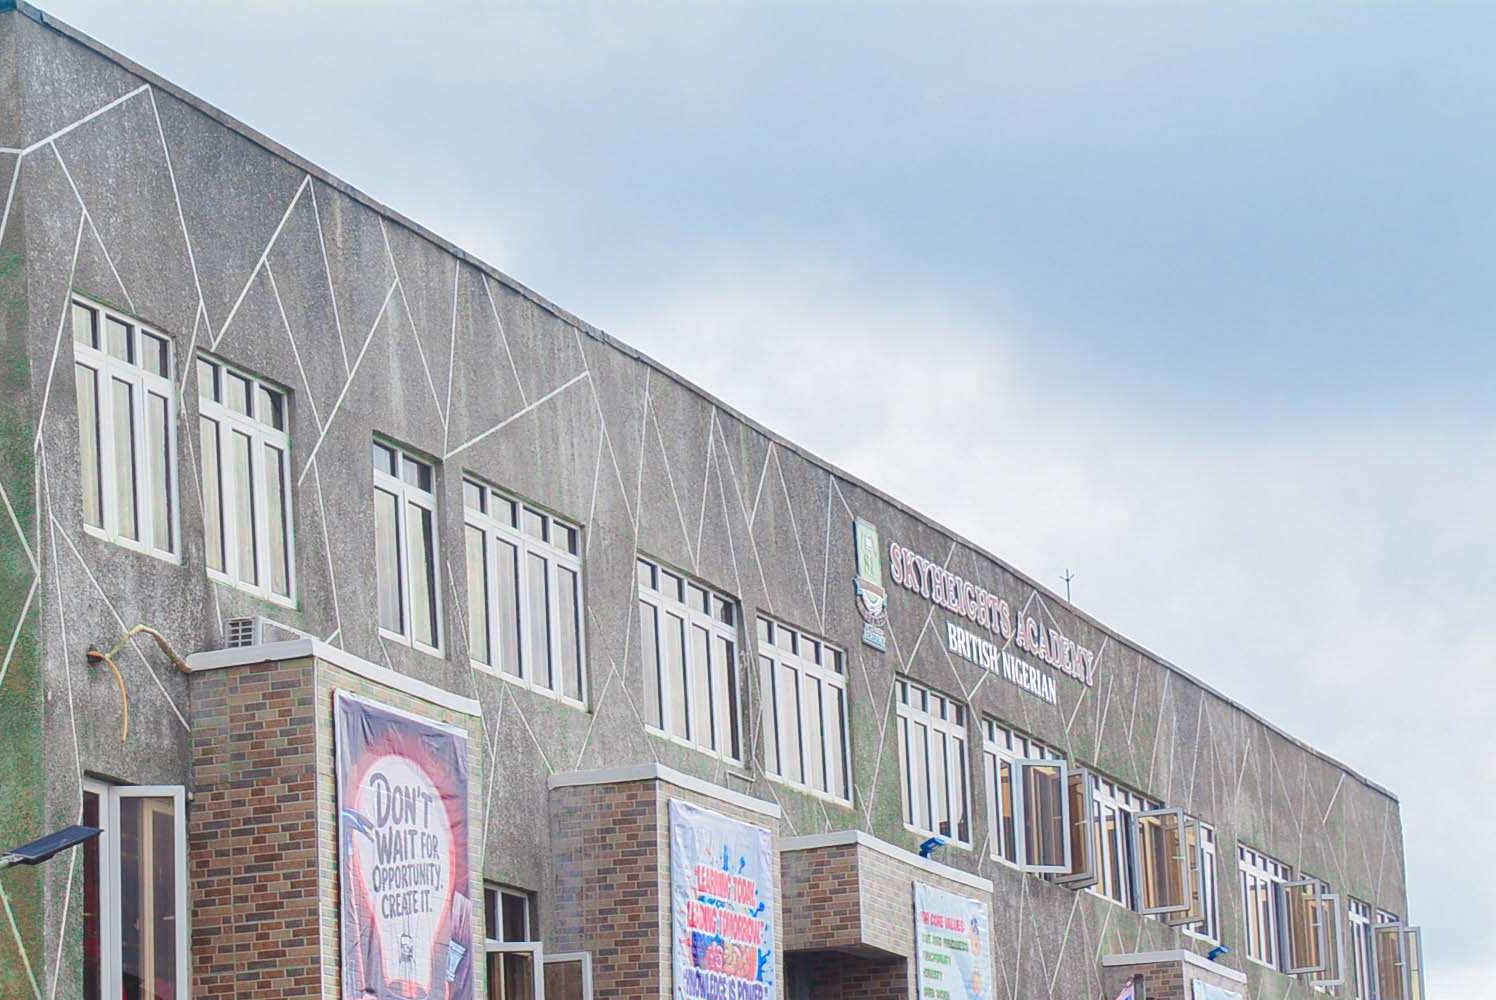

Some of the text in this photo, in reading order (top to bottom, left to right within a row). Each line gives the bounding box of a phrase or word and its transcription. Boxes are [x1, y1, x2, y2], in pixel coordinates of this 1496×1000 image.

[890, 543, 1094, 687] SKYHEIGHTS ACADEMY
[946, 622, 999, 675] BRITISH
[1002, 651, 1056, 706] NIGERIAN
[370, 773, 433, 828] DON'T
[375, 826, 440, 865] WAIT FOR
[372, 863, 444, 893] OPPORTUNITY.
[381, 889, 433, 919] CREATE IT.
[687, 900, 717, 934] LEADING
